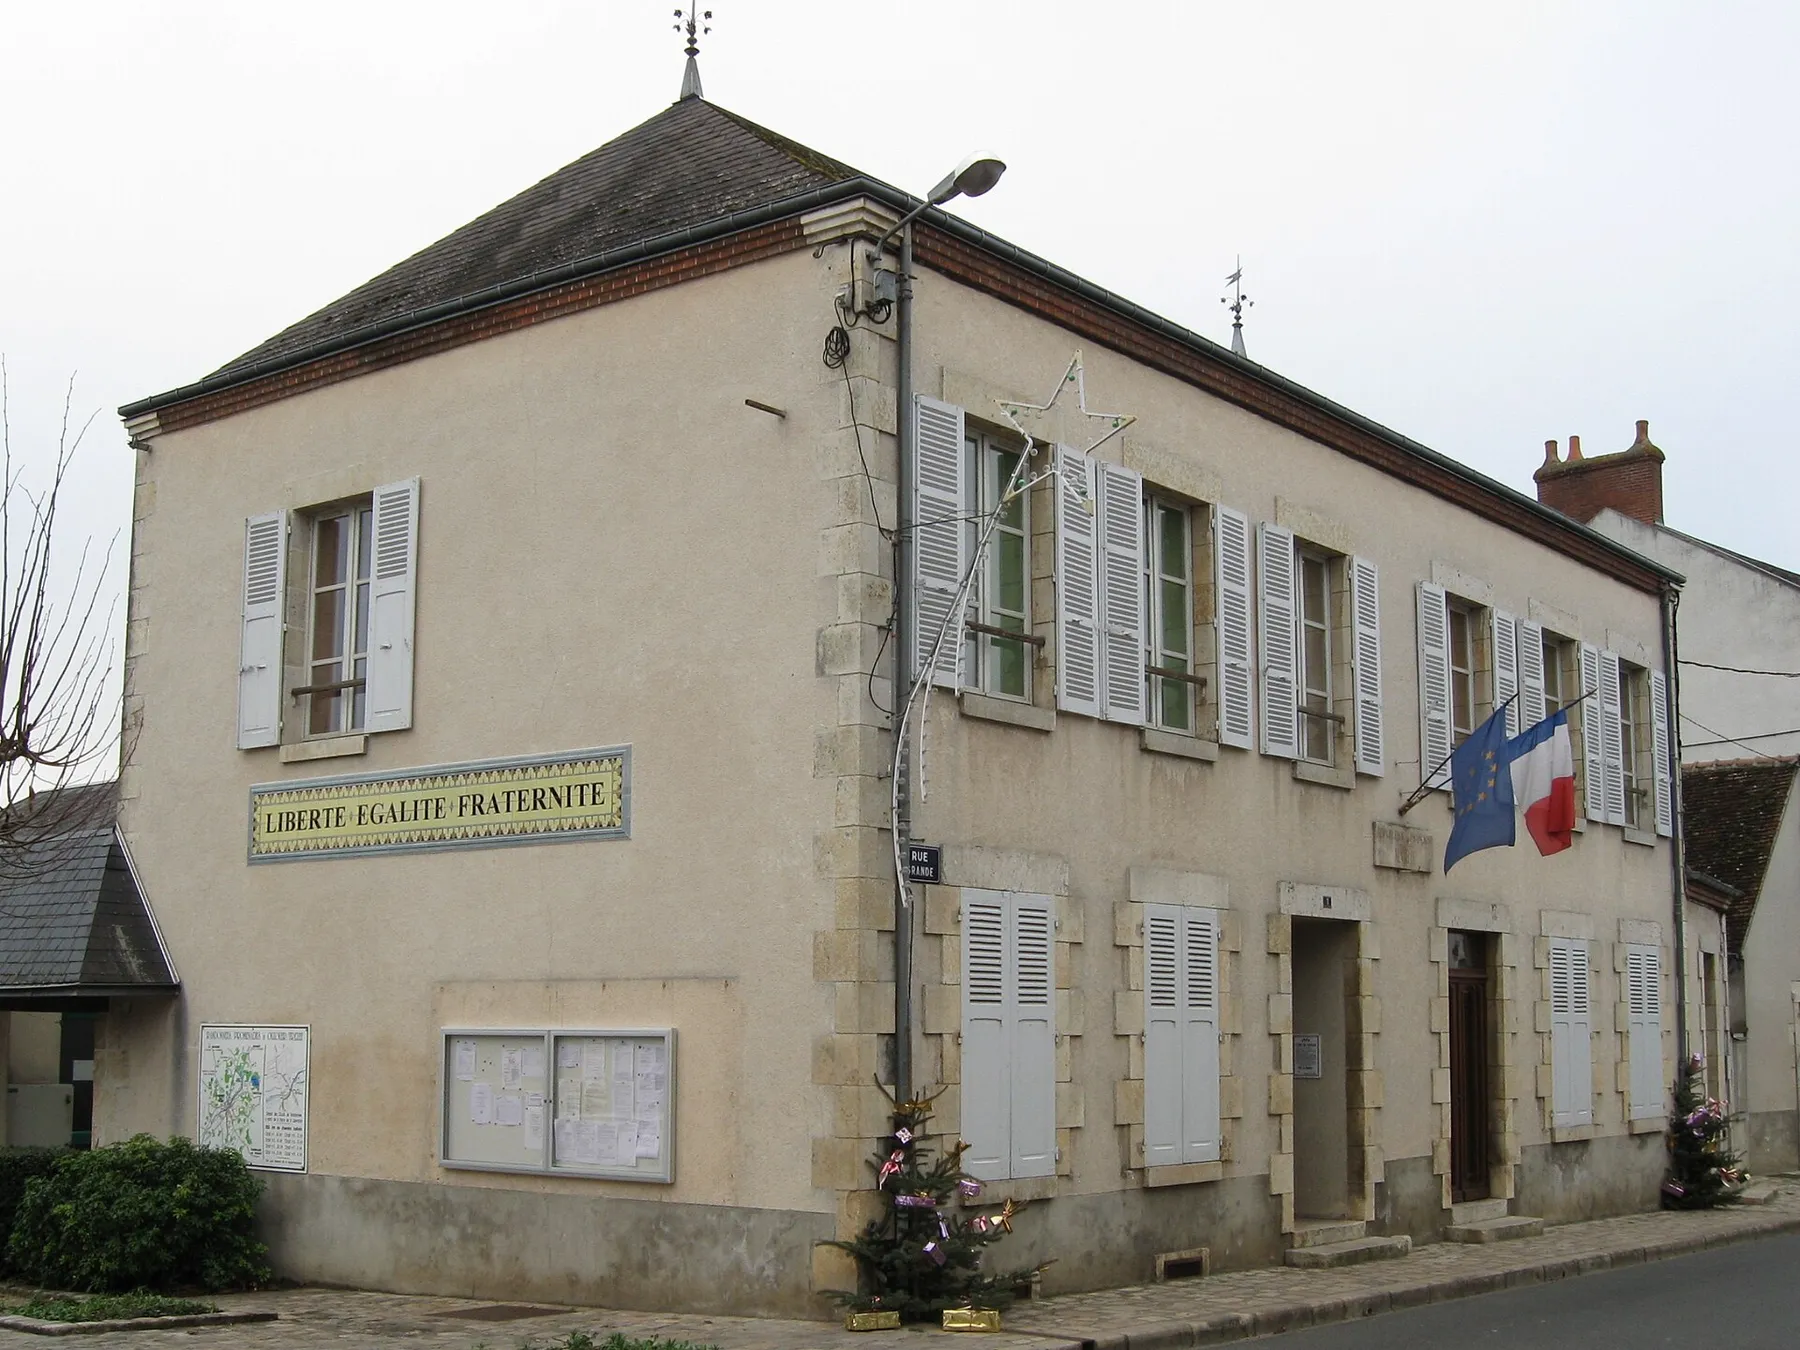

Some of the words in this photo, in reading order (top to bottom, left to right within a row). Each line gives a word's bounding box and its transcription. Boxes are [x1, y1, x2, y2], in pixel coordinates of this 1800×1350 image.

[265, 807, 346, 834] LIBERTE
[357, 797, 447, 826] EGALITE
[458, 782, 605, 818] FRATERNITE
[911, 850, 928, 862] RUE
[909, 866, 934, 877] RANDE
